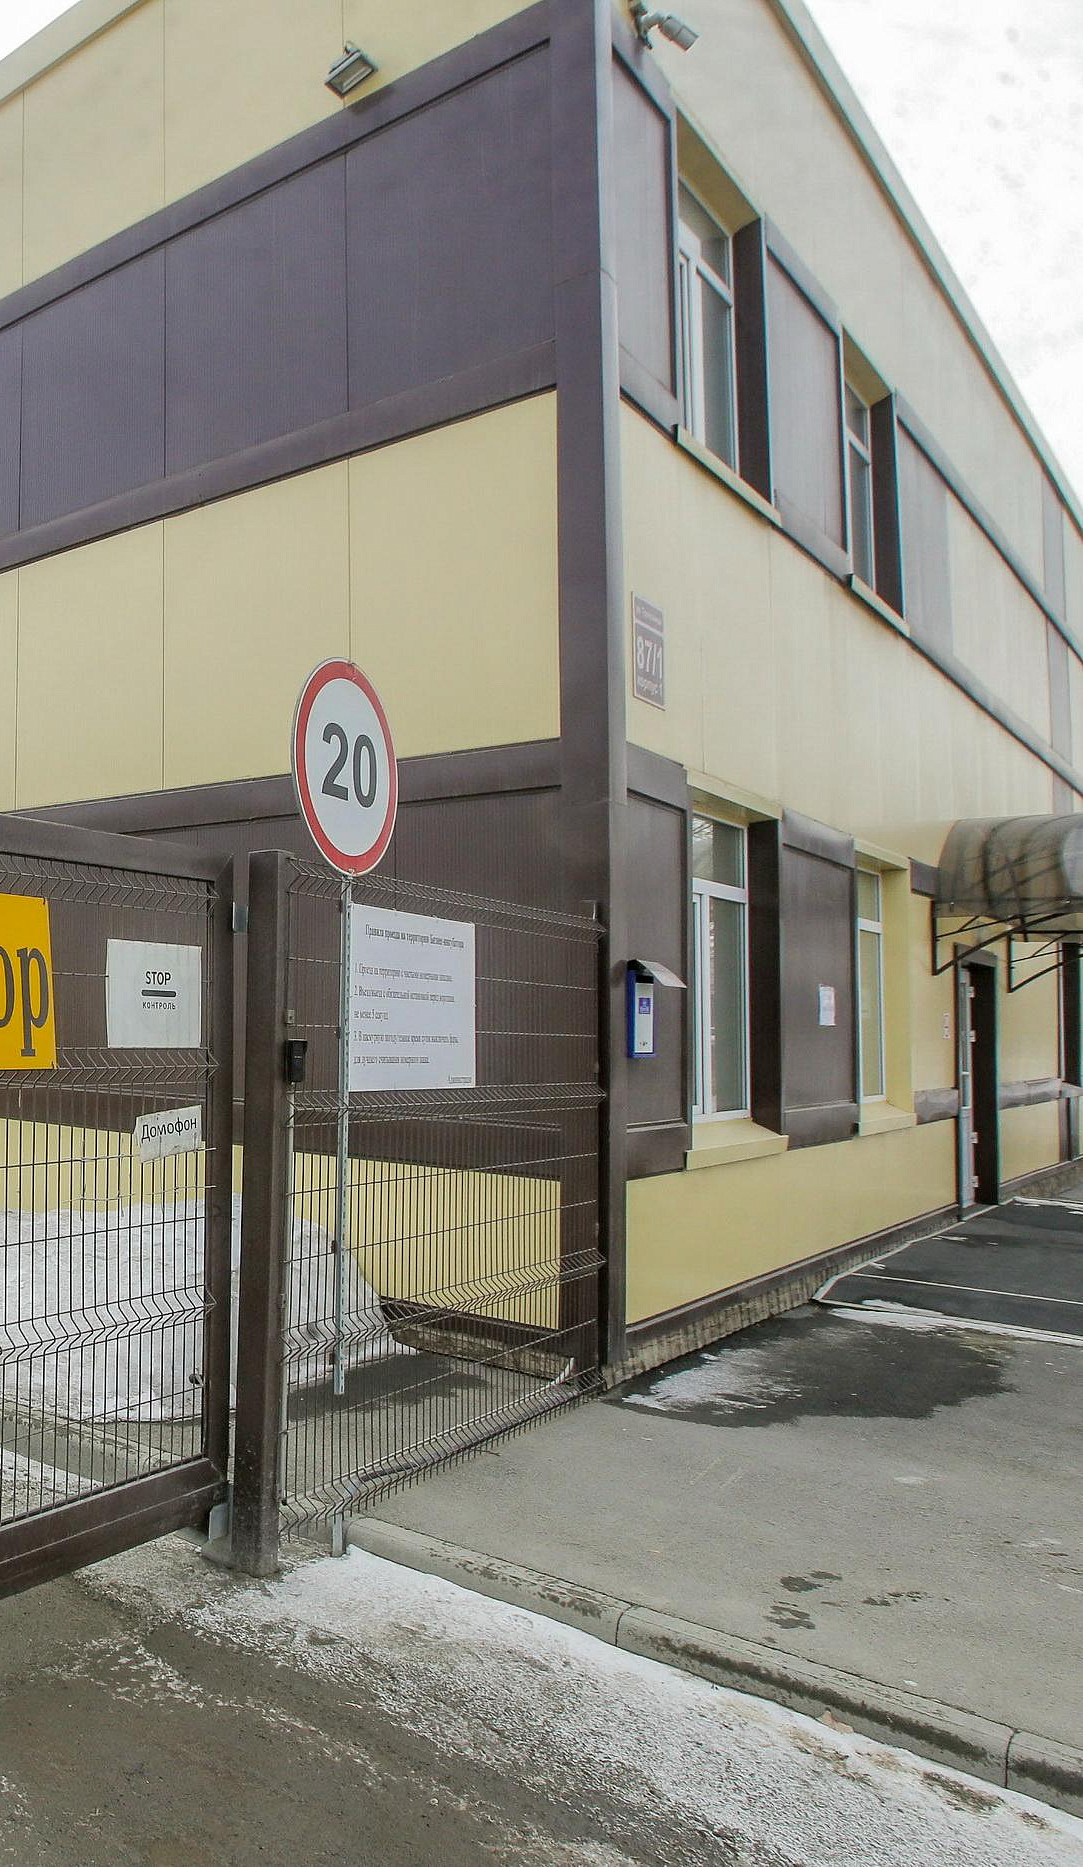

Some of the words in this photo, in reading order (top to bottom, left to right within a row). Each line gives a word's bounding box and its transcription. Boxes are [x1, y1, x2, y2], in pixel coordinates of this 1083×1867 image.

[637, 635, 663, 680] 87/1
[321, 722, 377, 808] 20
[145, 971, 171, 986] STOP
[142, 1001, 176, 1010] КОНТРОЛЬ
[141, 1116, 197, 1144] Домофон
